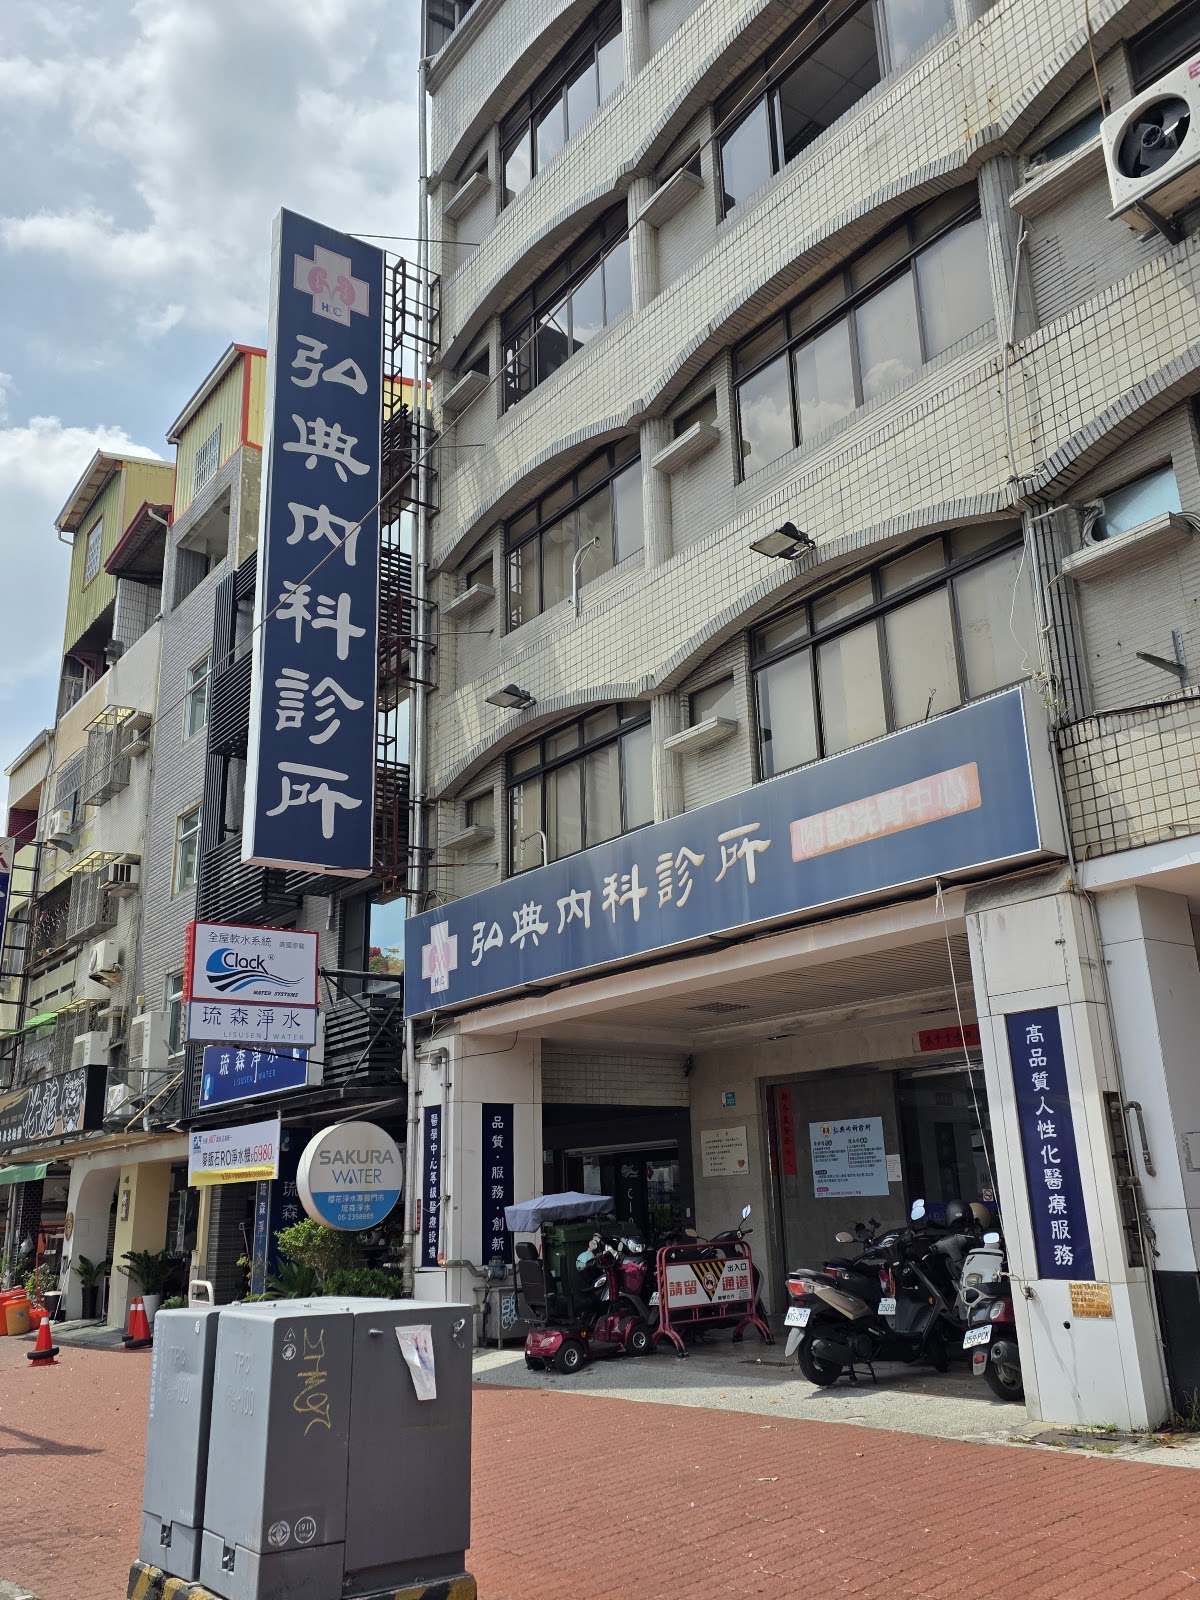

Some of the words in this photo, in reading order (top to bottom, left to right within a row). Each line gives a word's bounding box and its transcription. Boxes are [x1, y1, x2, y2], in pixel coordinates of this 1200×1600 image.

[265, 334, 371, 839] 弘典內科診所
[470, 822, 772, 967] 弘典內科診所
[208, 932, 272, 947] 全屋軟水系統
[223, 952, 267, 972] Clack
[202, 1006, 301, 1040] 琉森淨水
[223, 1031, 262, 1039] LISUSEN
[319, 1150, 394, 1165] SAKURA
[332, 1169, 382, 1184] WATER
[727, 1262, 747, 1272] 出入口
[669, 1280, 697, 1297] 請留
[722, 1275, 749, 1291] 通道
[298, 1522, 312, 1532] 1911
